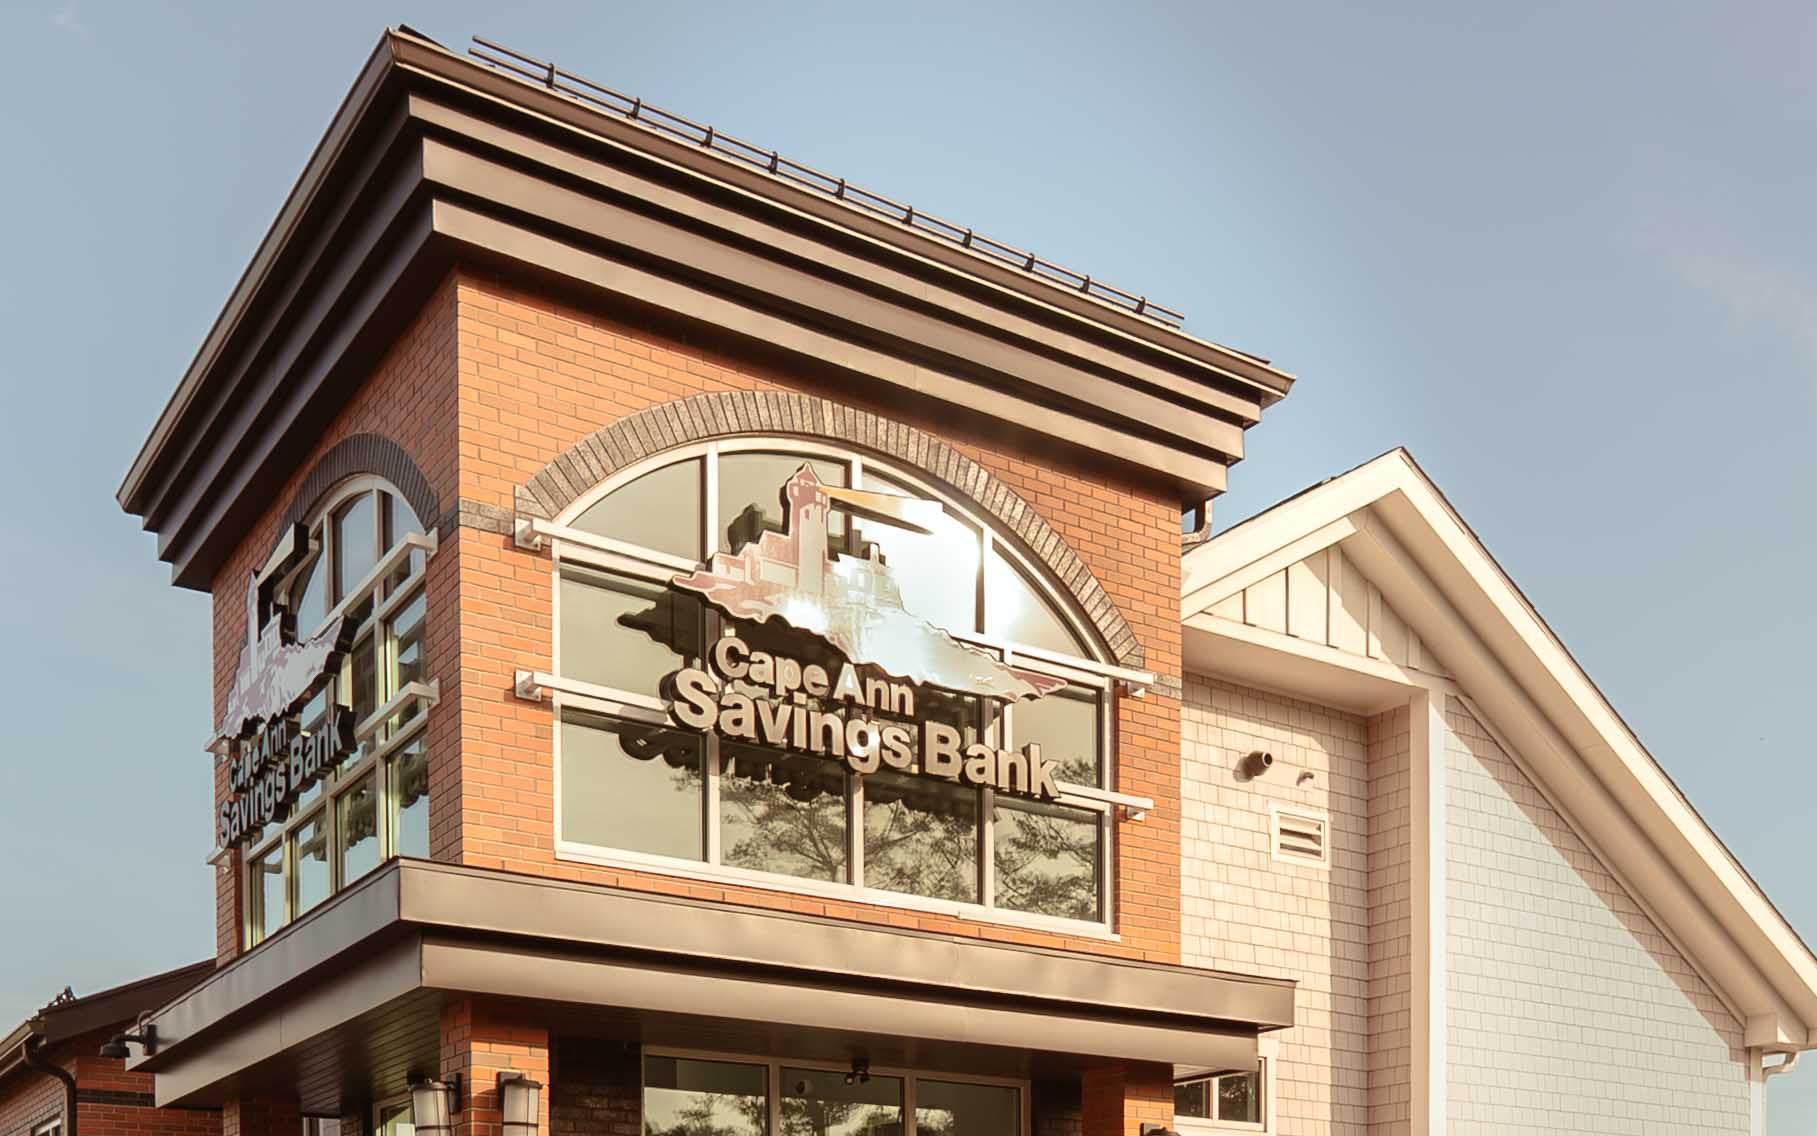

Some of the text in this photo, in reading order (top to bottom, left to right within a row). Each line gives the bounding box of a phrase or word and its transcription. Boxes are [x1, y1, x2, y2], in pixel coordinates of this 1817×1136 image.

[713, 636, 915, 717] Cape Ann
[219, 710, 344, 849] Savings Bank
[260, 719, 288, 762] Ann
[673, 668, 1061, 798] Savings Bank
